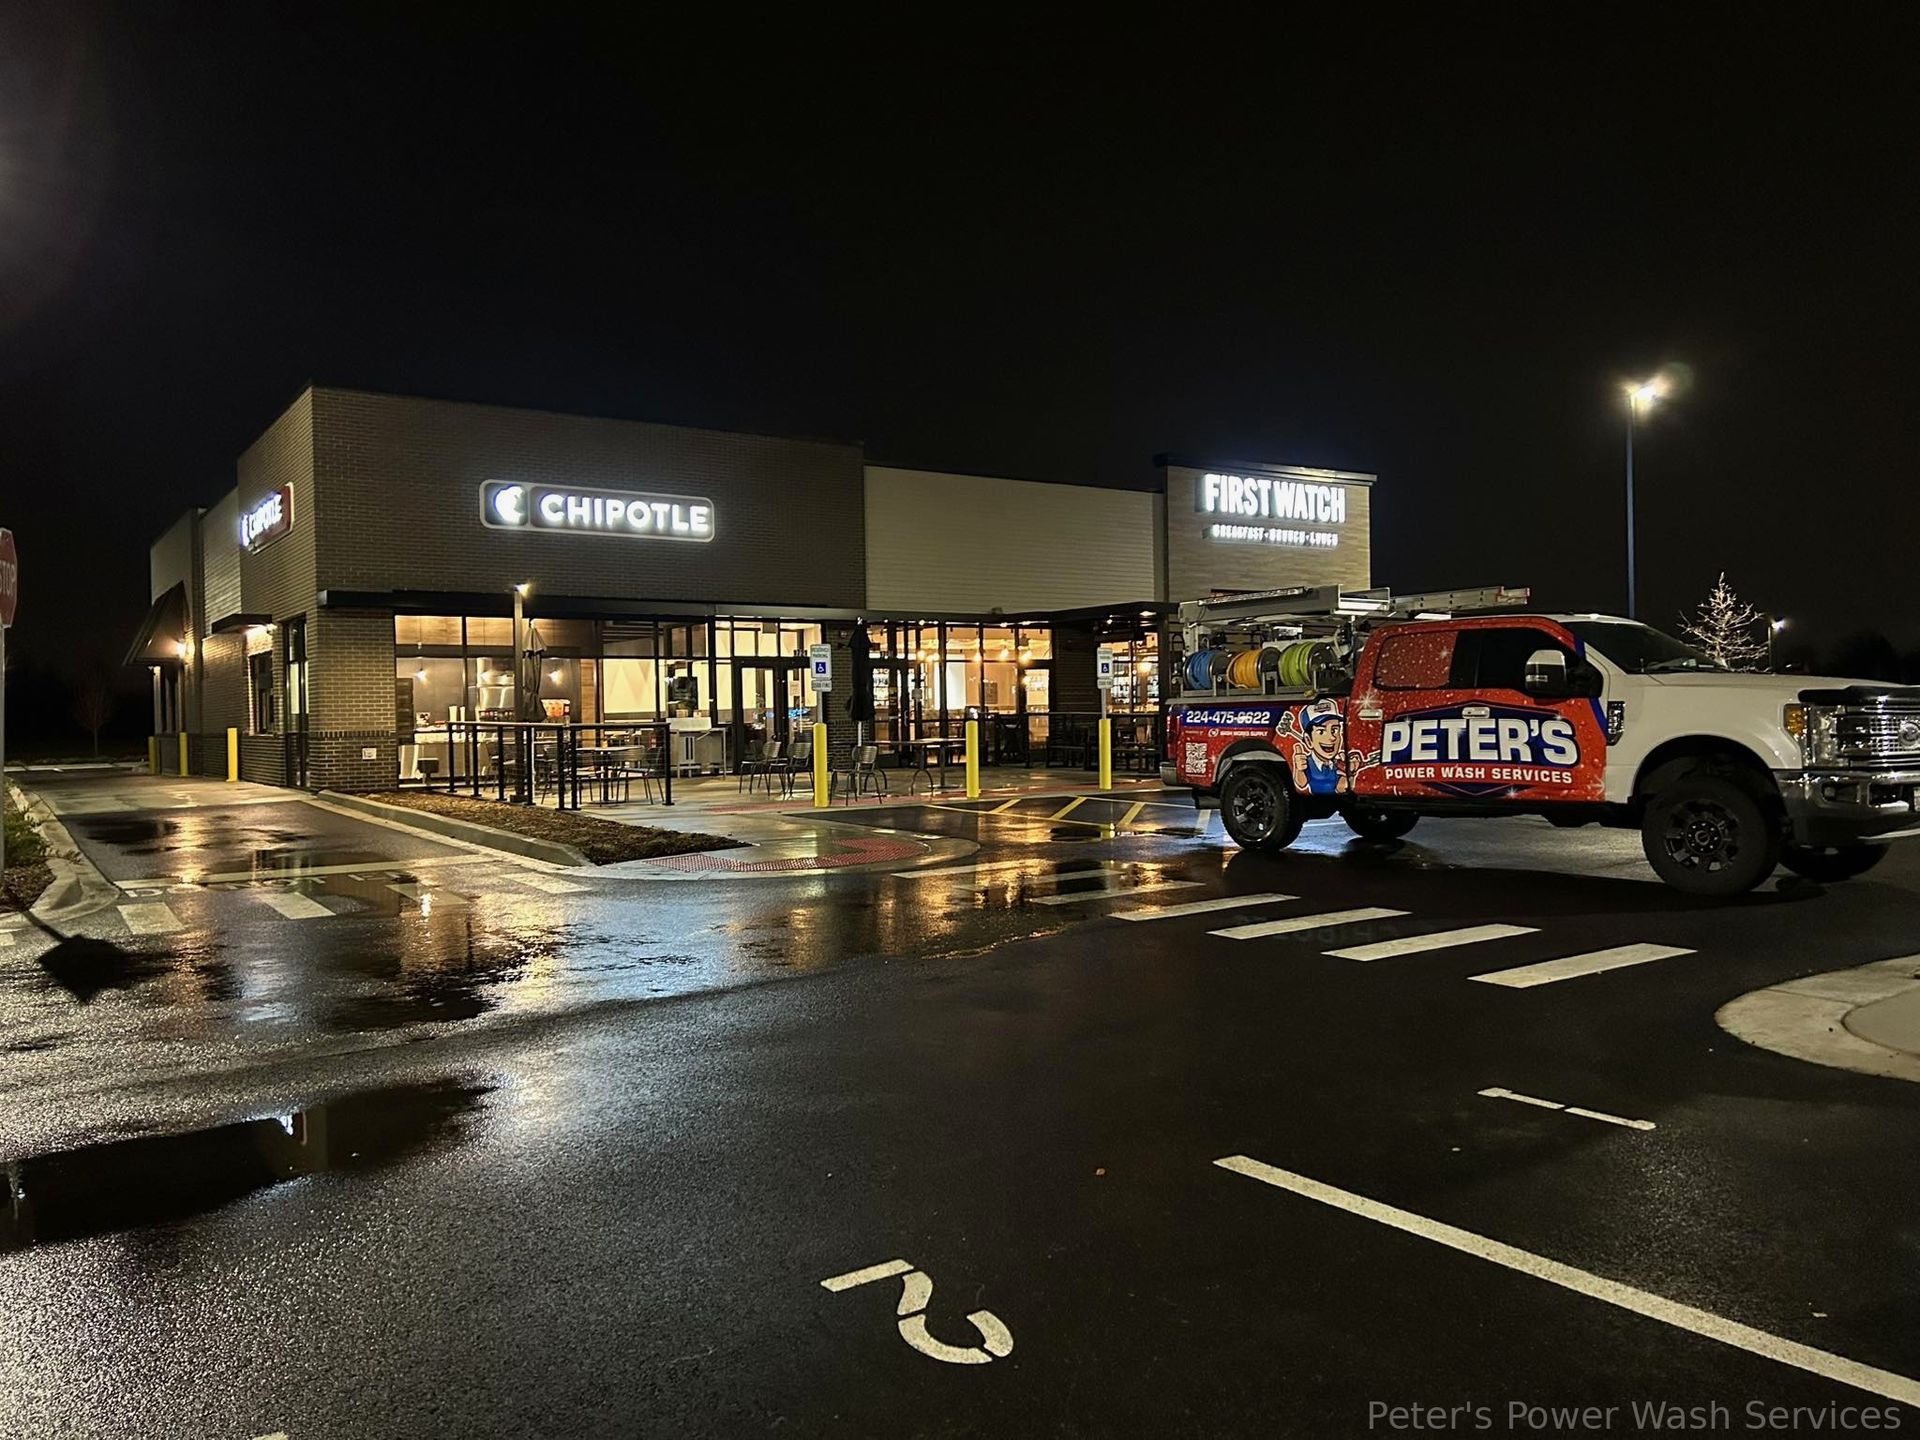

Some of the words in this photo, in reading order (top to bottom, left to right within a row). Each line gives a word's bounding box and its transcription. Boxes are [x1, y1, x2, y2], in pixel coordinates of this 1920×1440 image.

[540, 493, 710, 532] CHIPOTLE
[1204, 473, 1272, 516] FIRST
[1272, 480, 1346, 523] WATCH
[1185, 710, 1271, 724] 224-475-6622
[1381, 718, 1579, 766] PETER'S
[1385, 767, 1436, 780] POWER
[1441, 766, 1486, 779] WASH
[1491, 768, 1573, 784] SERVICES
[820, 1258, 1014, 1364] 2
